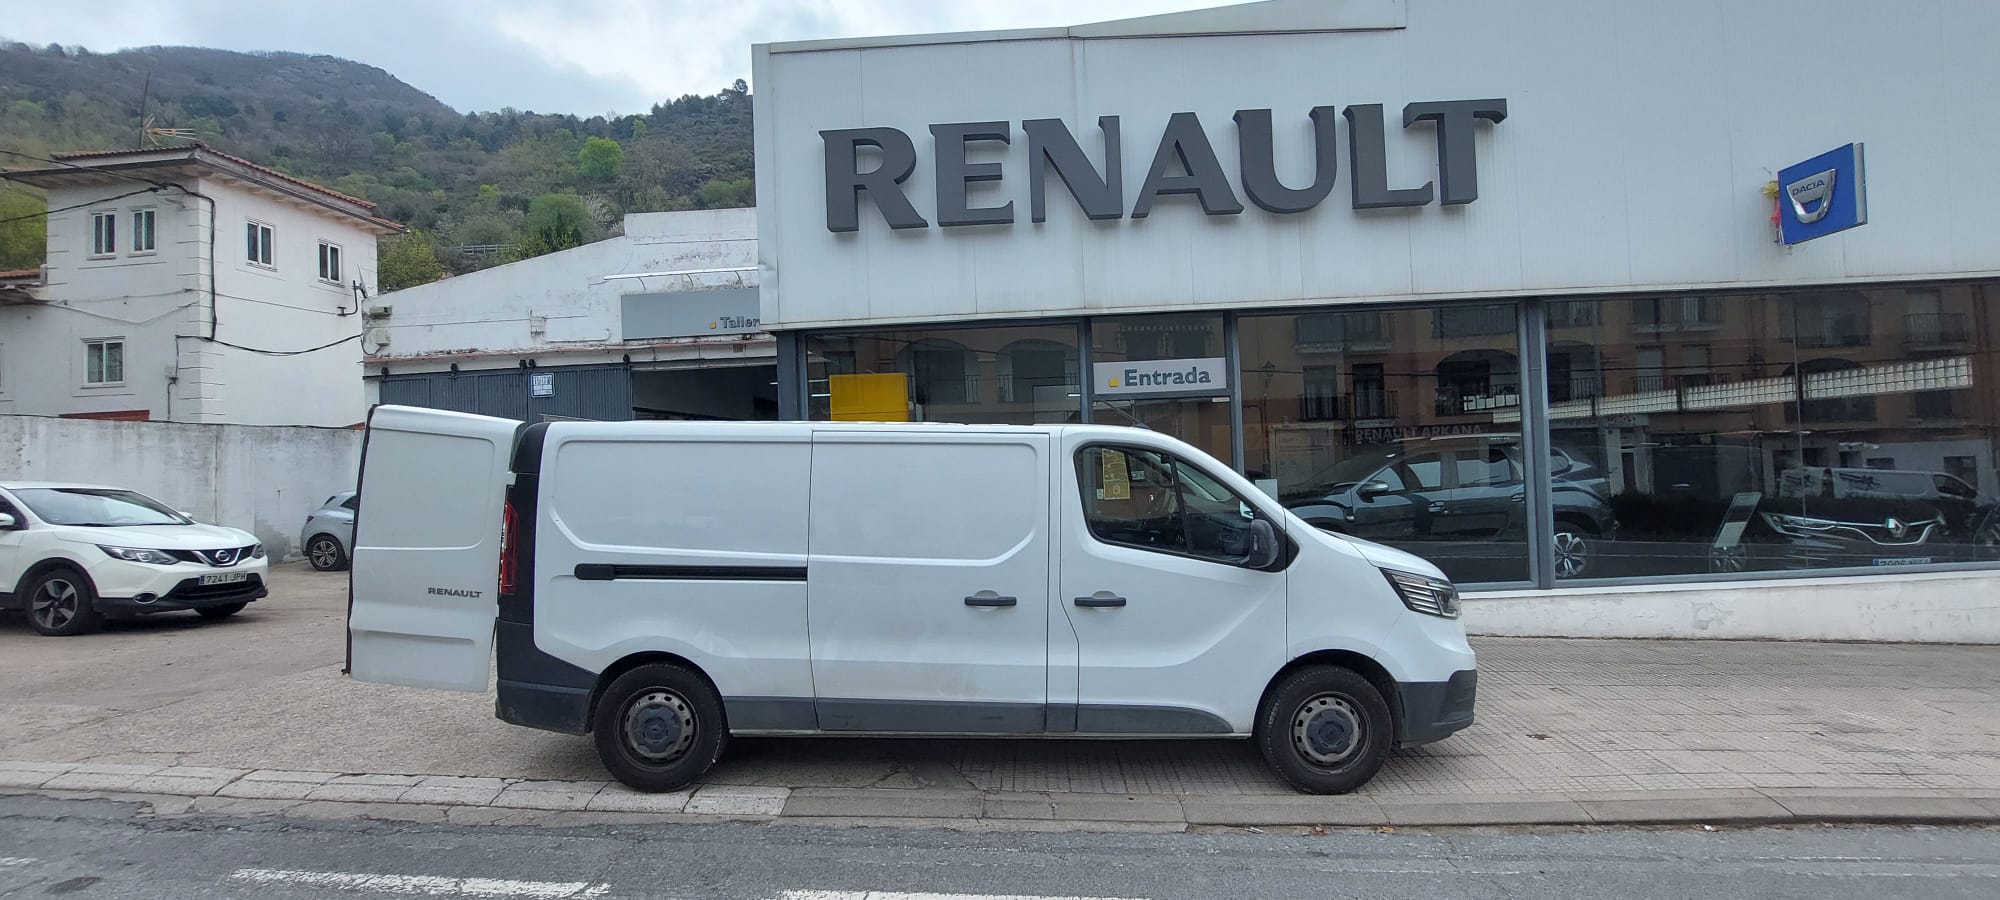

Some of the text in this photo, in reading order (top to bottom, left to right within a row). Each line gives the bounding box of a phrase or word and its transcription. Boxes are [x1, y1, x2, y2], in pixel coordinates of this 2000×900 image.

[818, 98, 1507, 233] RENAULT
[1792, 180, 1825, 196] DACIA
[1124, 366, 1211, 387] Entrada
[1354, 424, 1481, 441] RENAULT ARKANA
[206, 574, 228, 584] 7241
[427, 587, 483, 598] RENAULT
